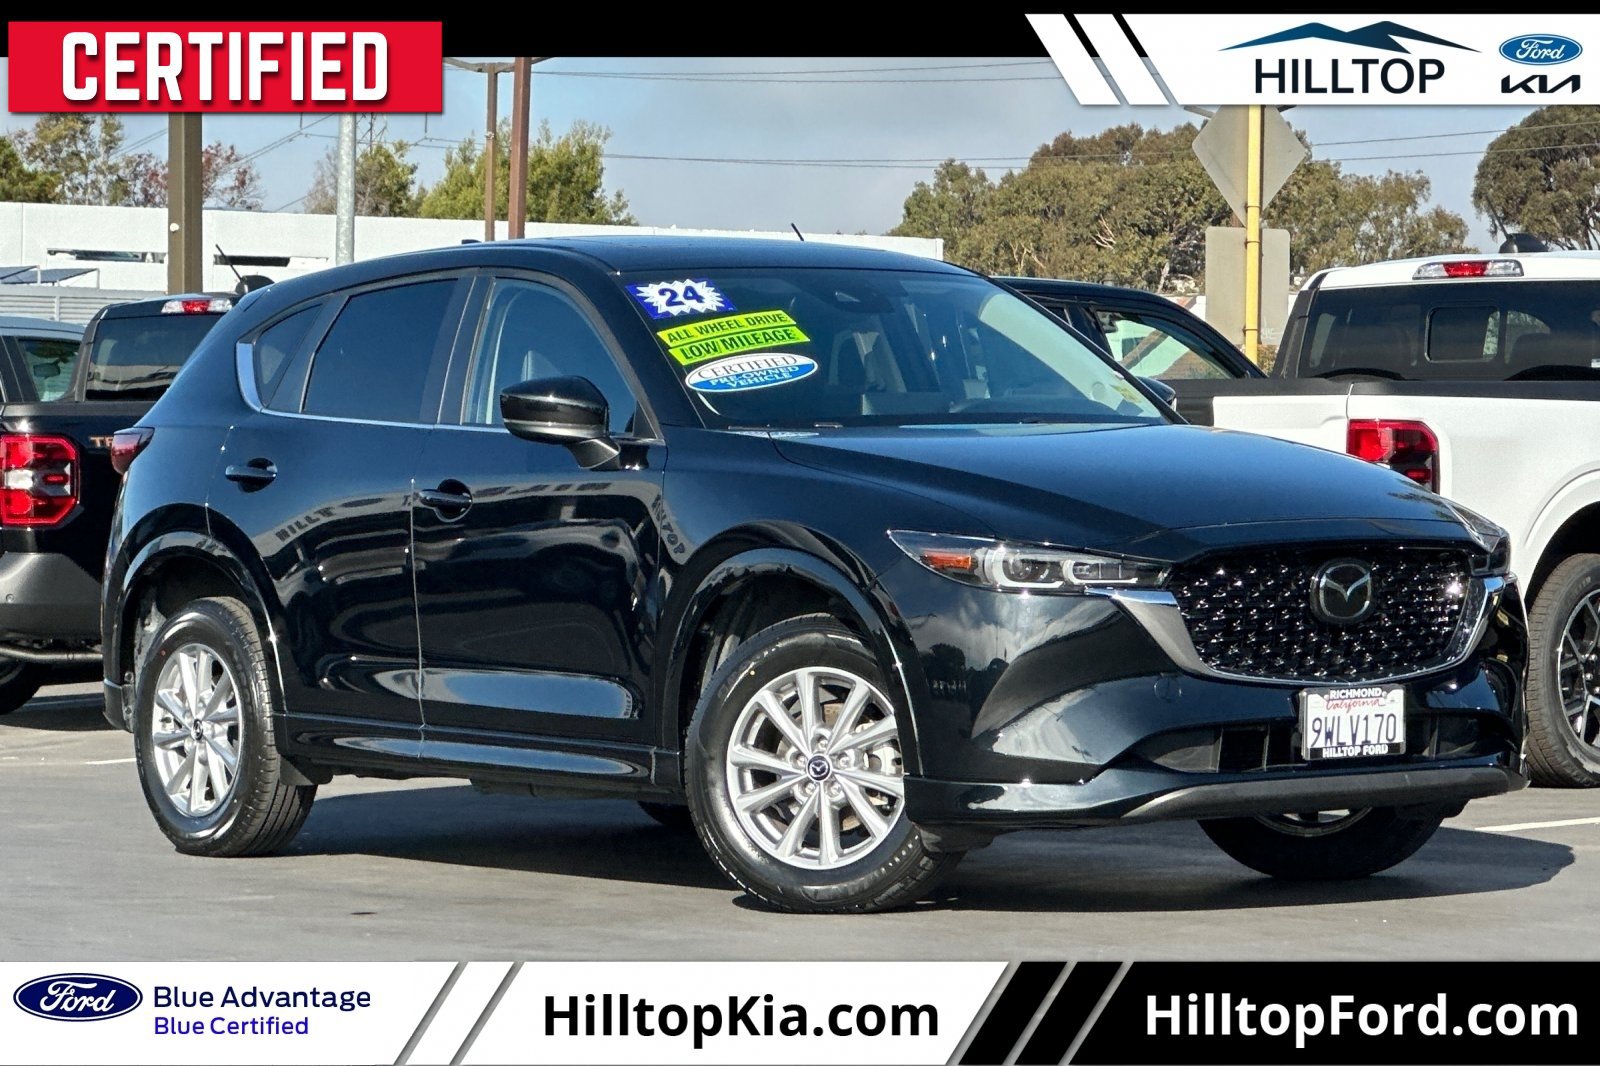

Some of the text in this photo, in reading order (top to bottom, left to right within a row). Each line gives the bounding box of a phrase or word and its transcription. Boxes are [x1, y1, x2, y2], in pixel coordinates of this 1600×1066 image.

[658, 285, 705, 307] 24
[667, 312, 789, 344] ALL WHEEL DRIVE
[680, 329, 795, 361] LOW MILEAGE
[698, 355, 798, 379] CERTIFIED
[709, 366, 800, 386] PRE-OWNED
[725, 372, 793, 388] VEHICLE
[1329, 688, 1383, 699] RICHMOND
[1325, 698, 1386, 713] California
[1311, 714, 1397, 747] 9WLV170
[1322, 743, 1388, 758] HILLTOP FORD
